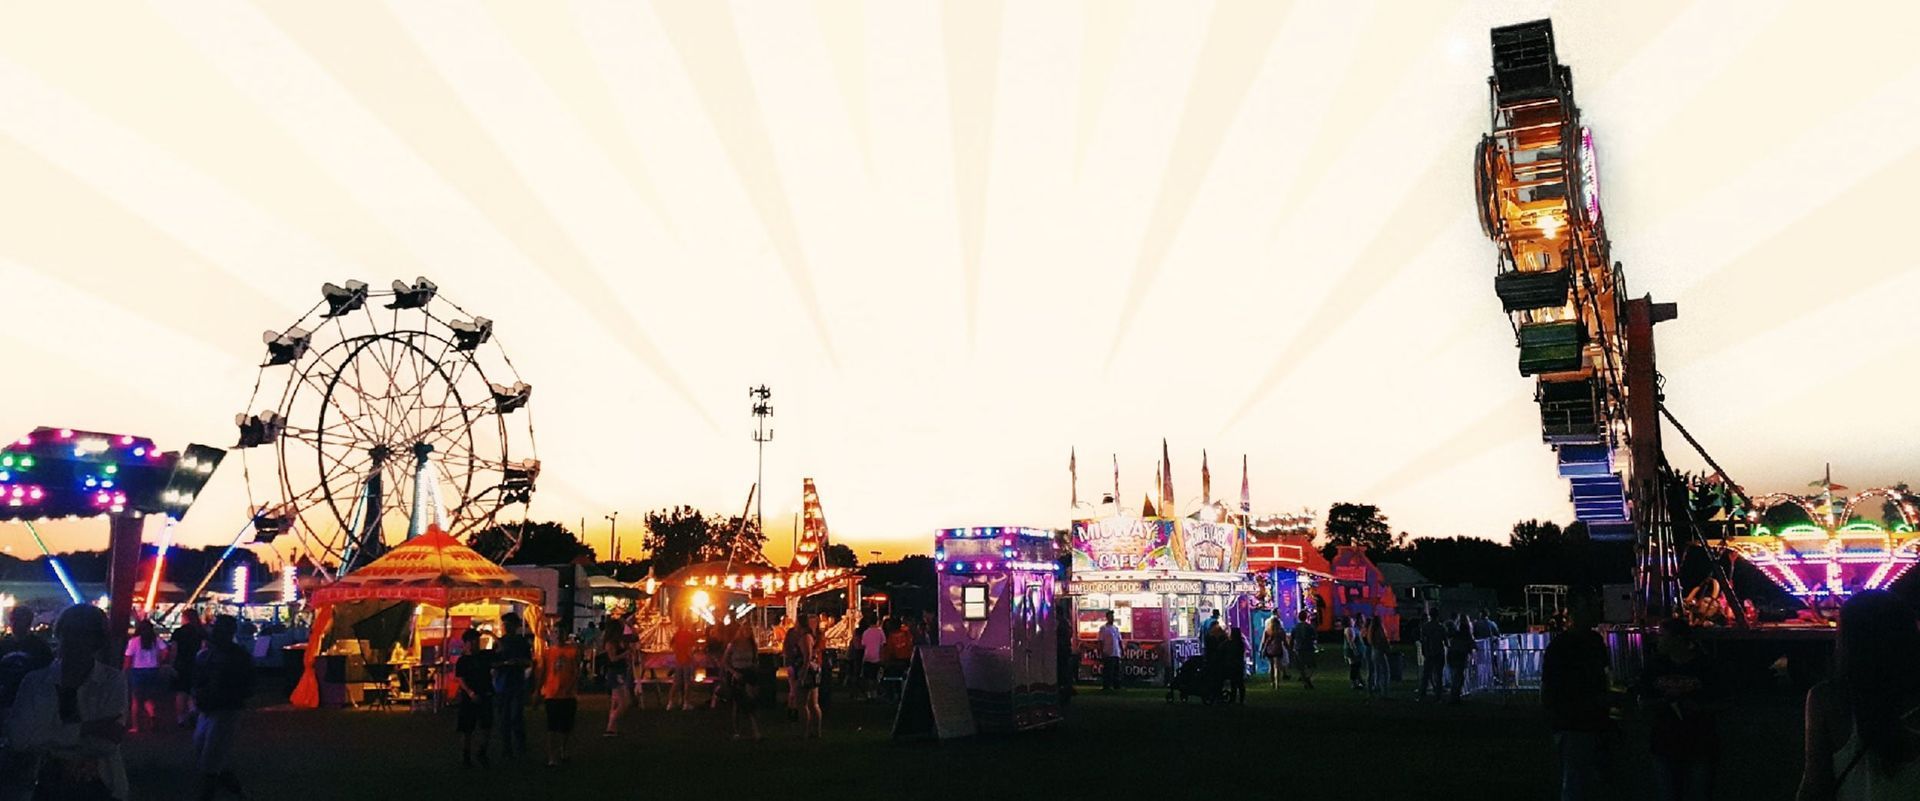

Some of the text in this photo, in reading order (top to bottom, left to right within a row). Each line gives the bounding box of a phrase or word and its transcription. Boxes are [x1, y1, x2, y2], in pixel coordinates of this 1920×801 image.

[1078, 519, 1157, 542] MIDWAY
[1099, 554, 1138, 568] CAFE
[1175, 643, 1201, 658] FUNNEL
